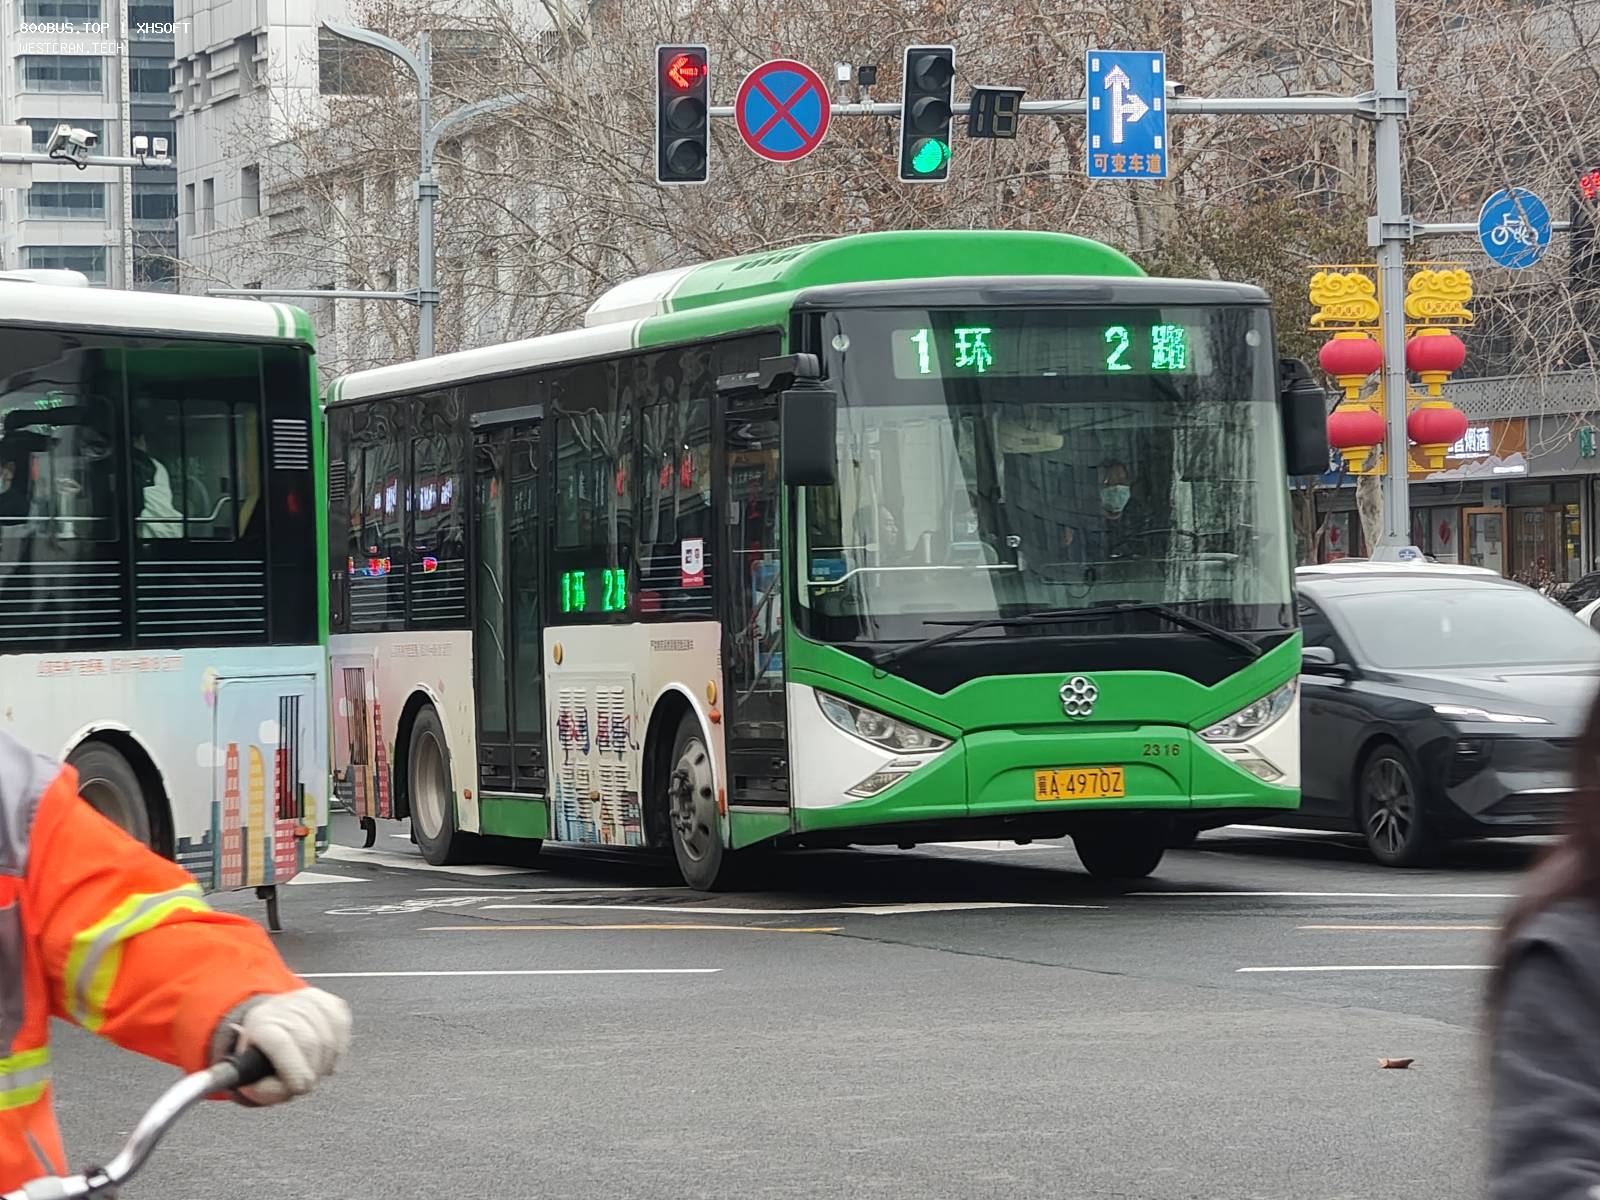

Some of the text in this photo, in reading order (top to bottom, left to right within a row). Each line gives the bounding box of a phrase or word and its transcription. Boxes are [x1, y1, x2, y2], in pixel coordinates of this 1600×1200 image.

[1093, 153, 1162, 174] 可变车道
[1143, 743, 1180, 757] 2316
